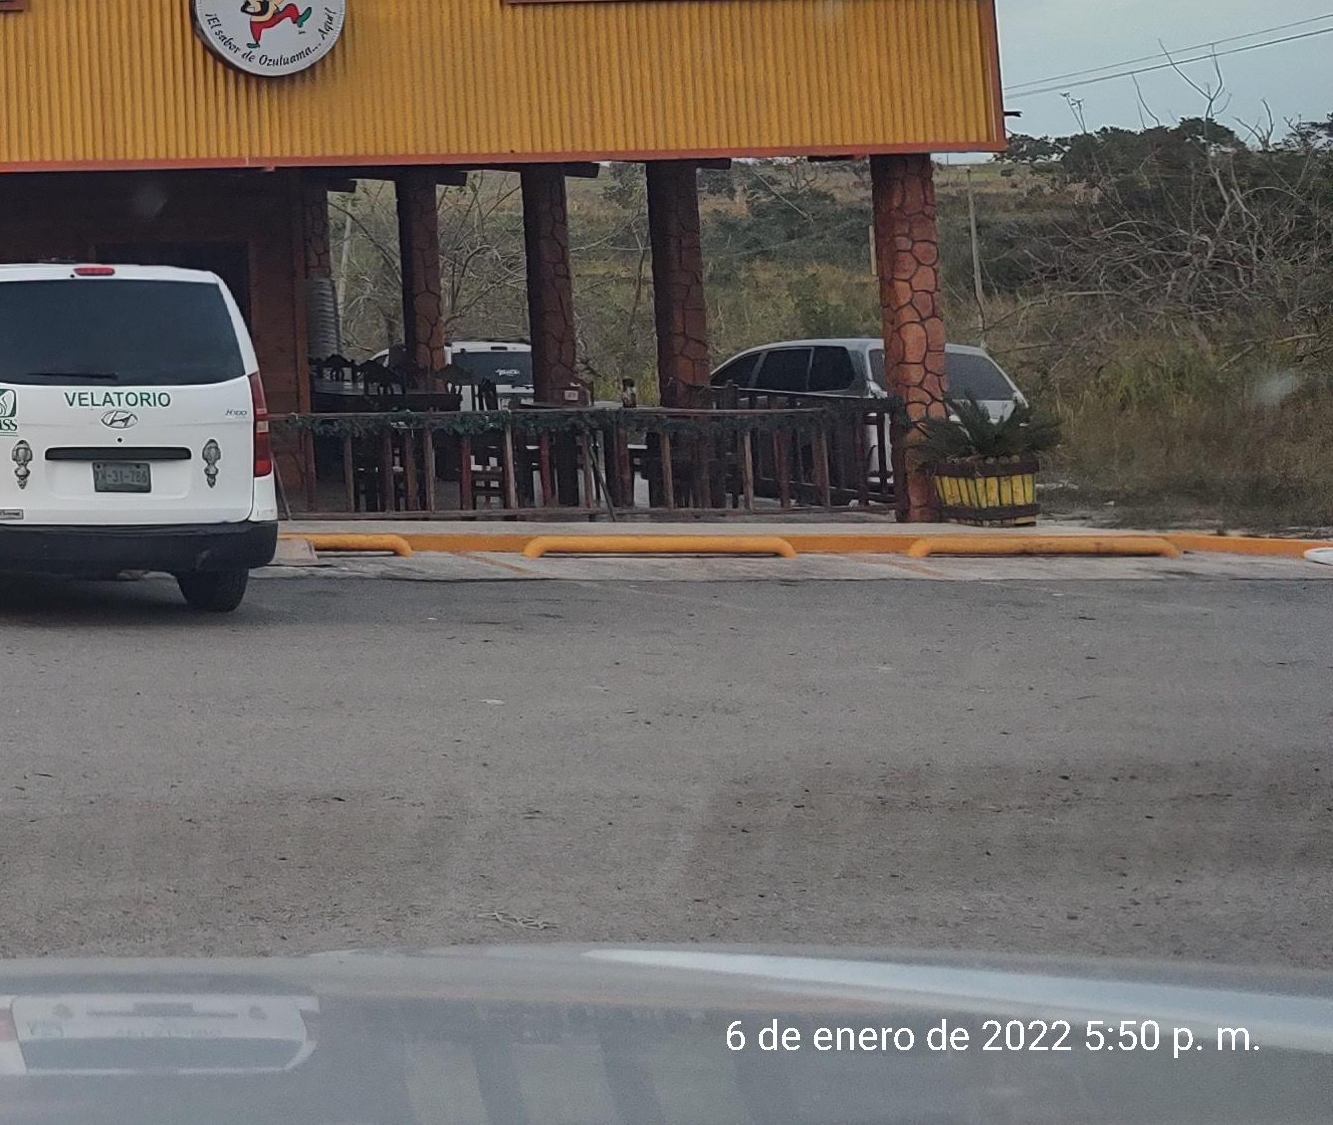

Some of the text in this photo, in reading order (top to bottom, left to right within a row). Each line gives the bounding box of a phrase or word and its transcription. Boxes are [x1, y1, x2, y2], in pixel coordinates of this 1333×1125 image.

[214, 29, 241, 54] sabor
[241, 50, 256, 63] de
[64, 391, 172, 408] VELATORIO
